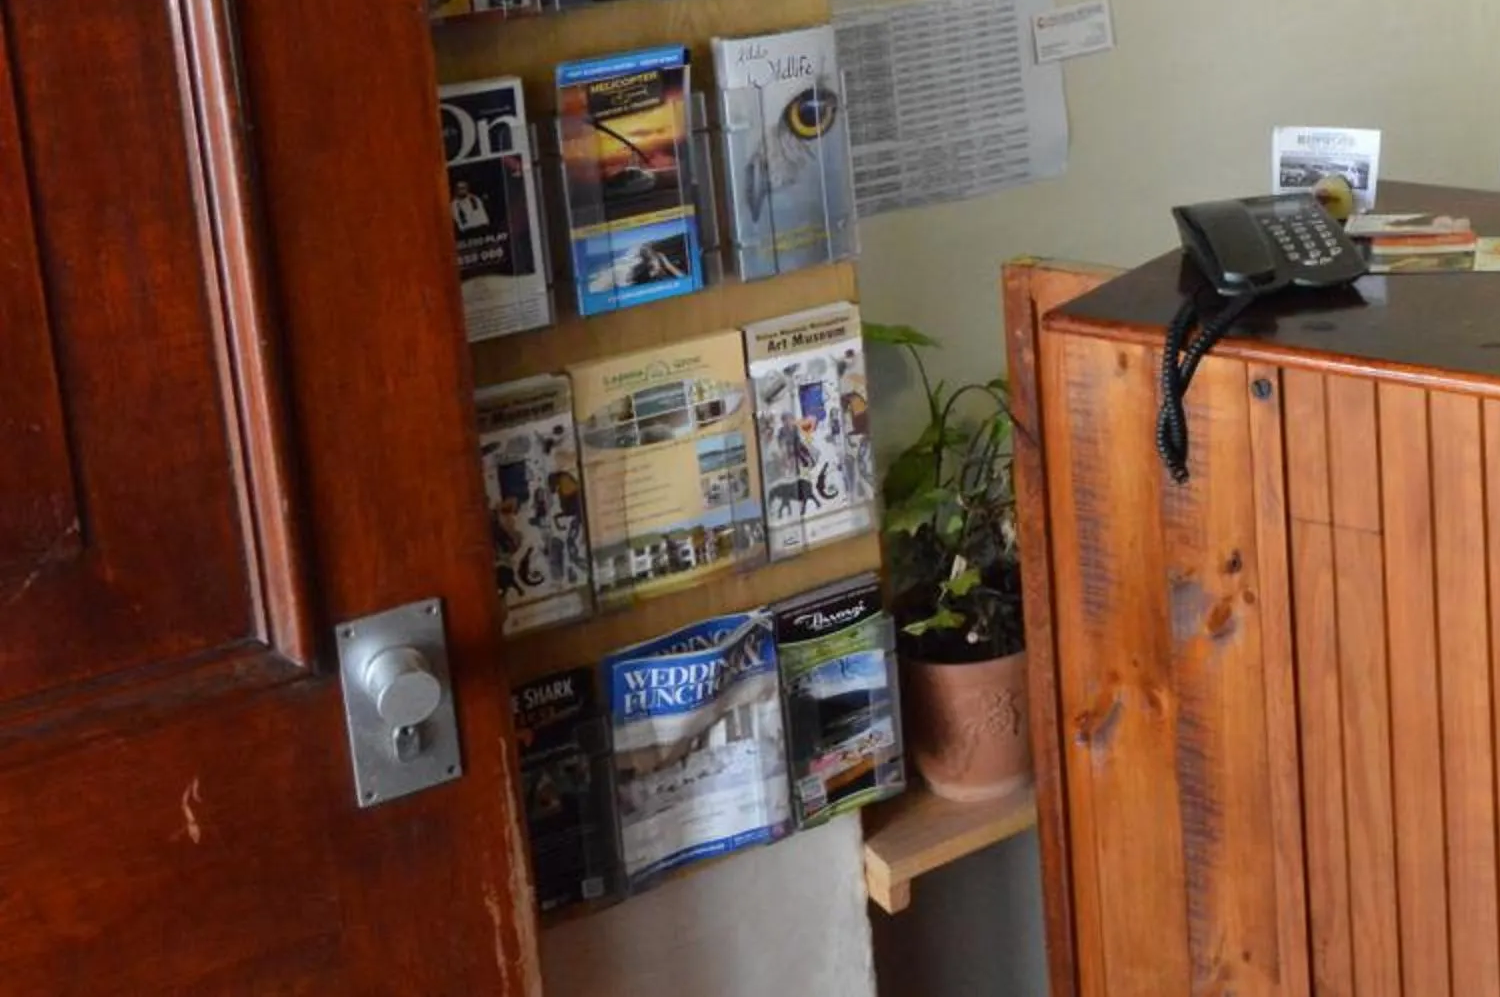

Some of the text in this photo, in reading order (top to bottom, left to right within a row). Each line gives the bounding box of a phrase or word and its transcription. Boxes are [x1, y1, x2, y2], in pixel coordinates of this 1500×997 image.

[768, 326, 846, 353] Art Museum
[523, 675, 574, 711] SHARK
